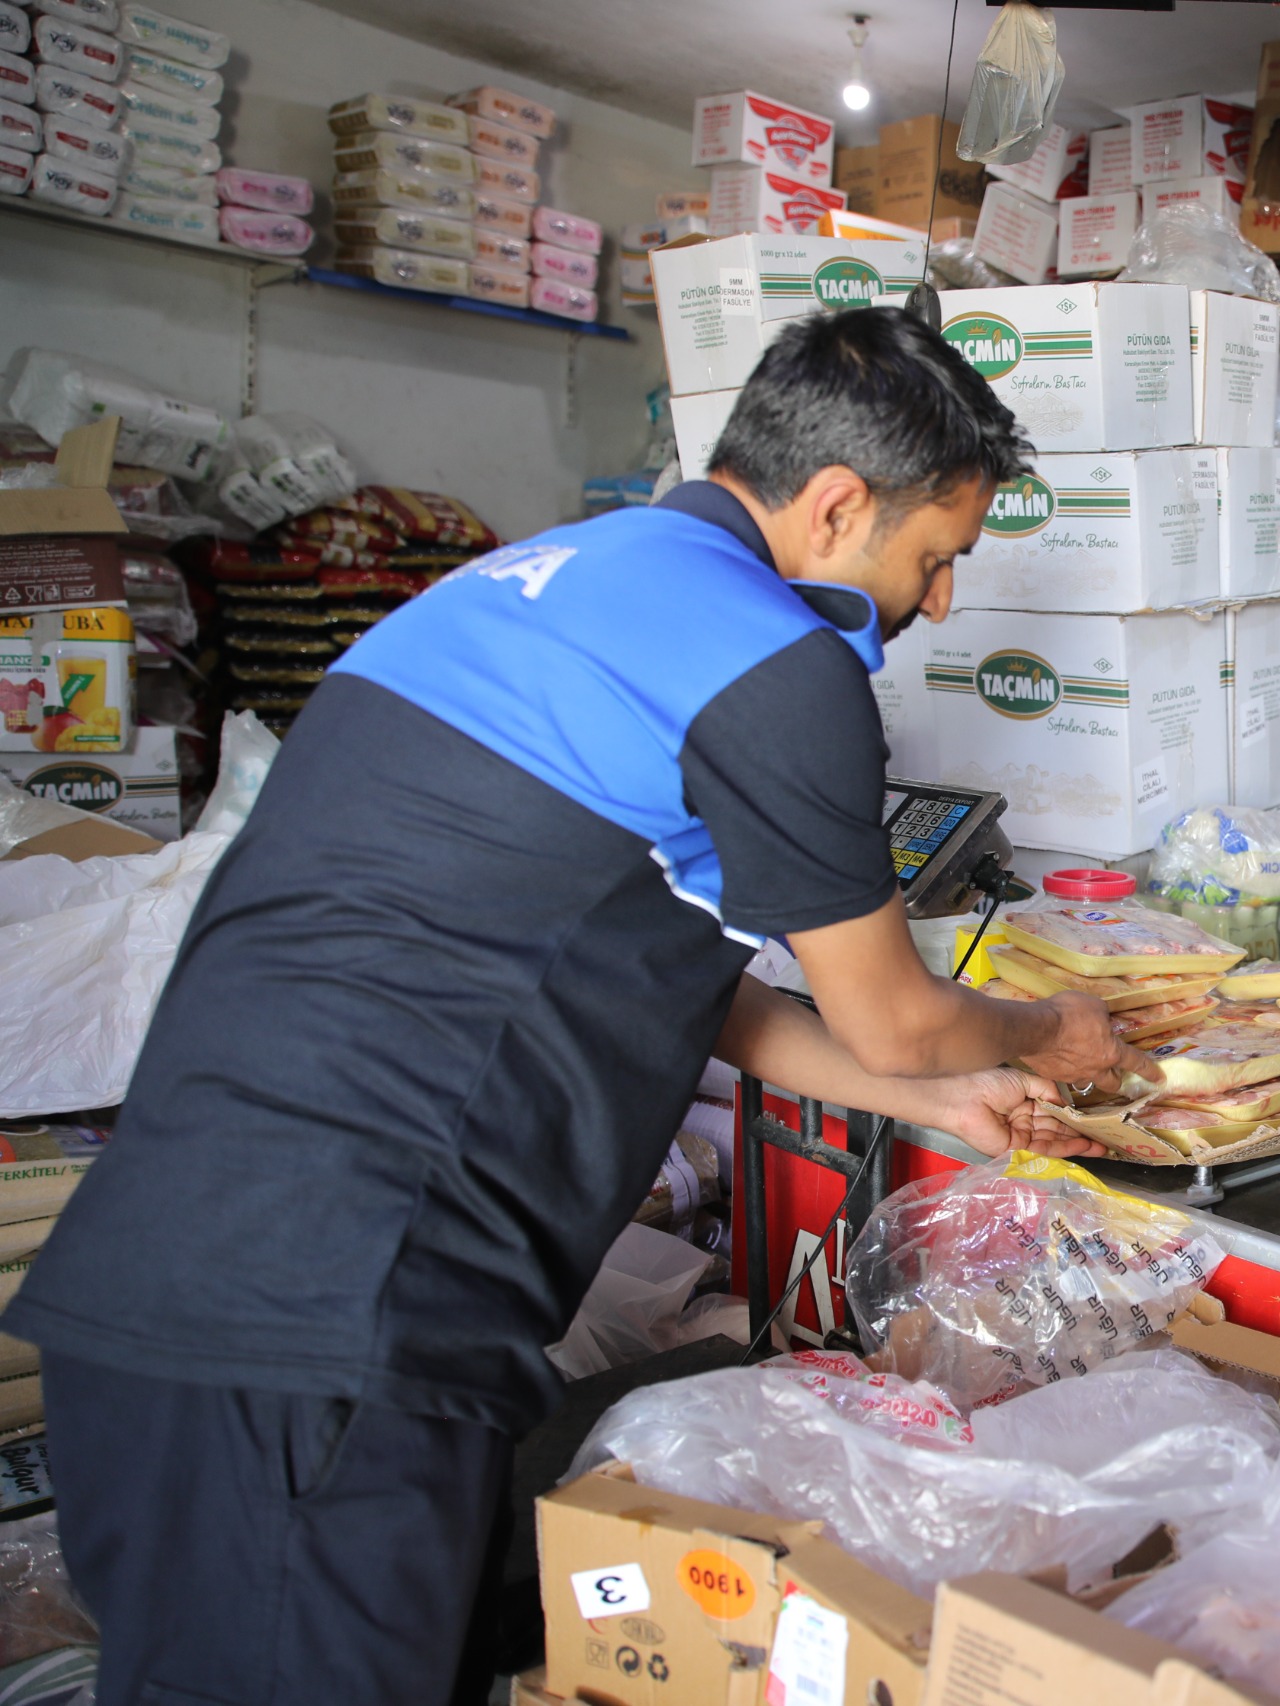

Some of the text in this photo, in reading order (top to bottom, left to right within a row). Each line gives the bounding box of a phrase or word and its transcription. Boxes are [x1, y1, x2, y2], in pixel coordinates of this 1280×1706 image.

[680, 286, 707, 300] PÜTÜN
[728, 278, 743, 286] 9MM
[818, 278, 880, 302] TAÇMİN
[723, 297, 751, 307] FASÜLYE
[1127, 334, 1171, 346] PÜTÜN GIDA
[987, 493, 1048, 520] ÇMİN
[877, 680, 895, 690] GIDA
[981, 673, 1055, 702] TAÇMİN
[1179, 685, 1196, 697] GIDA
[1141, 769, 1159, 782] İTHAL
[31, 781, 117, 804] TAÇMİN
[926, 801, 934, 811] 8
[940, 803, 948, 813] 9
[906, 825, 915, 835] 2
[920, 828, 928, 837] 3
[917, 813, 924, 823] 5
[930, 816, 939, 826] 6
[899, 852, 924, 864] M3 M4
[1003, 1215, 1042, 1257] UĞUR
[1051, 1217, 1087, 1265] UĞUR
[1092, 1231, 1128, 1276] UĞUR
[1130, 1240, 1169, 1284] UĞUR
[994, 1277, 1033, 1326] UĞUR
[1086, 1293, 1118, 1341] UĞUR
[0, 1446, 40, 1495] Bulgur
[595, 1575, 628, 1605] 3
[689, 1566, 745, 1598] 1900
